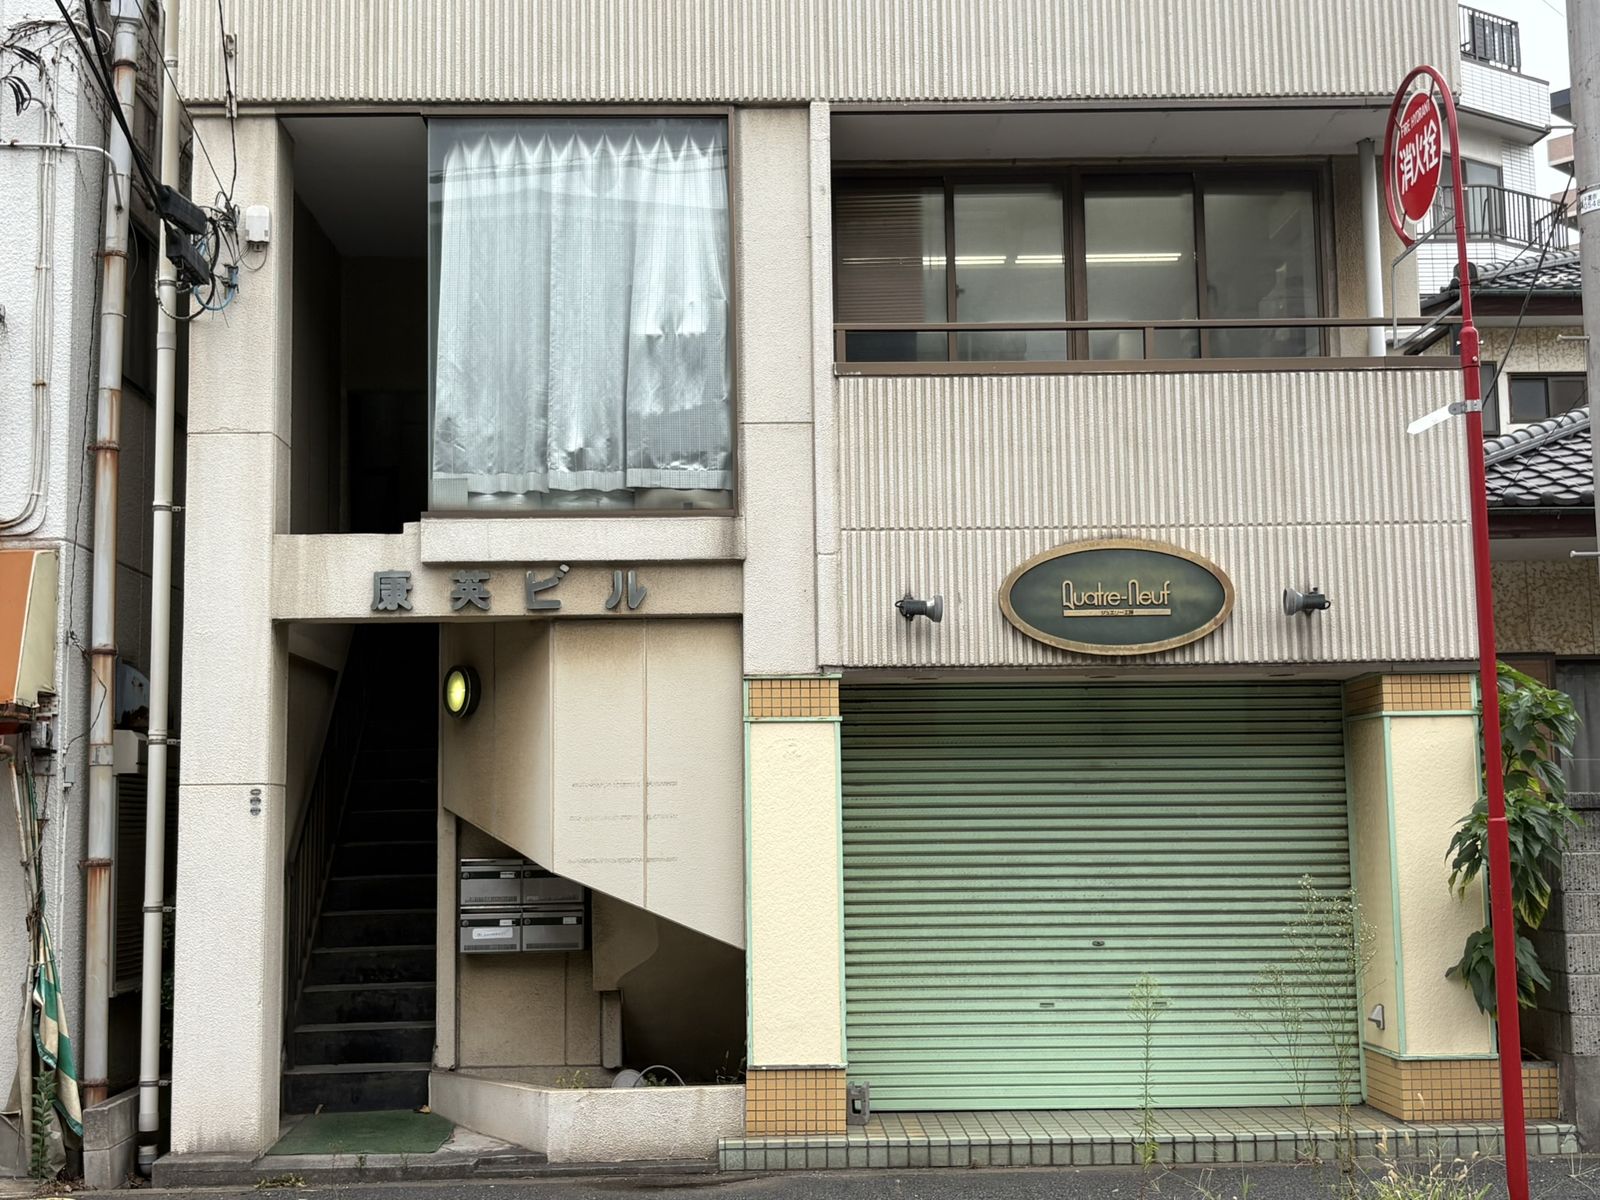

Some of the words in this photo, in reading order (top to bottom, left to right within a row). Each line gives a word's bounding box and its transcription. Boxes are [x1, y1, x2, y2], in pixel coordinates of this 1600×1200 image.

[1401, 119, 1411, 139] FIRE
[1411, 99, 1430, 129] HYDRANT
[1400, 119, 1438, 195] 消火栓
[371, 564, 647, 611] 康英ビル
[1062, 579, 1171, 610] Quatre-Neuf
